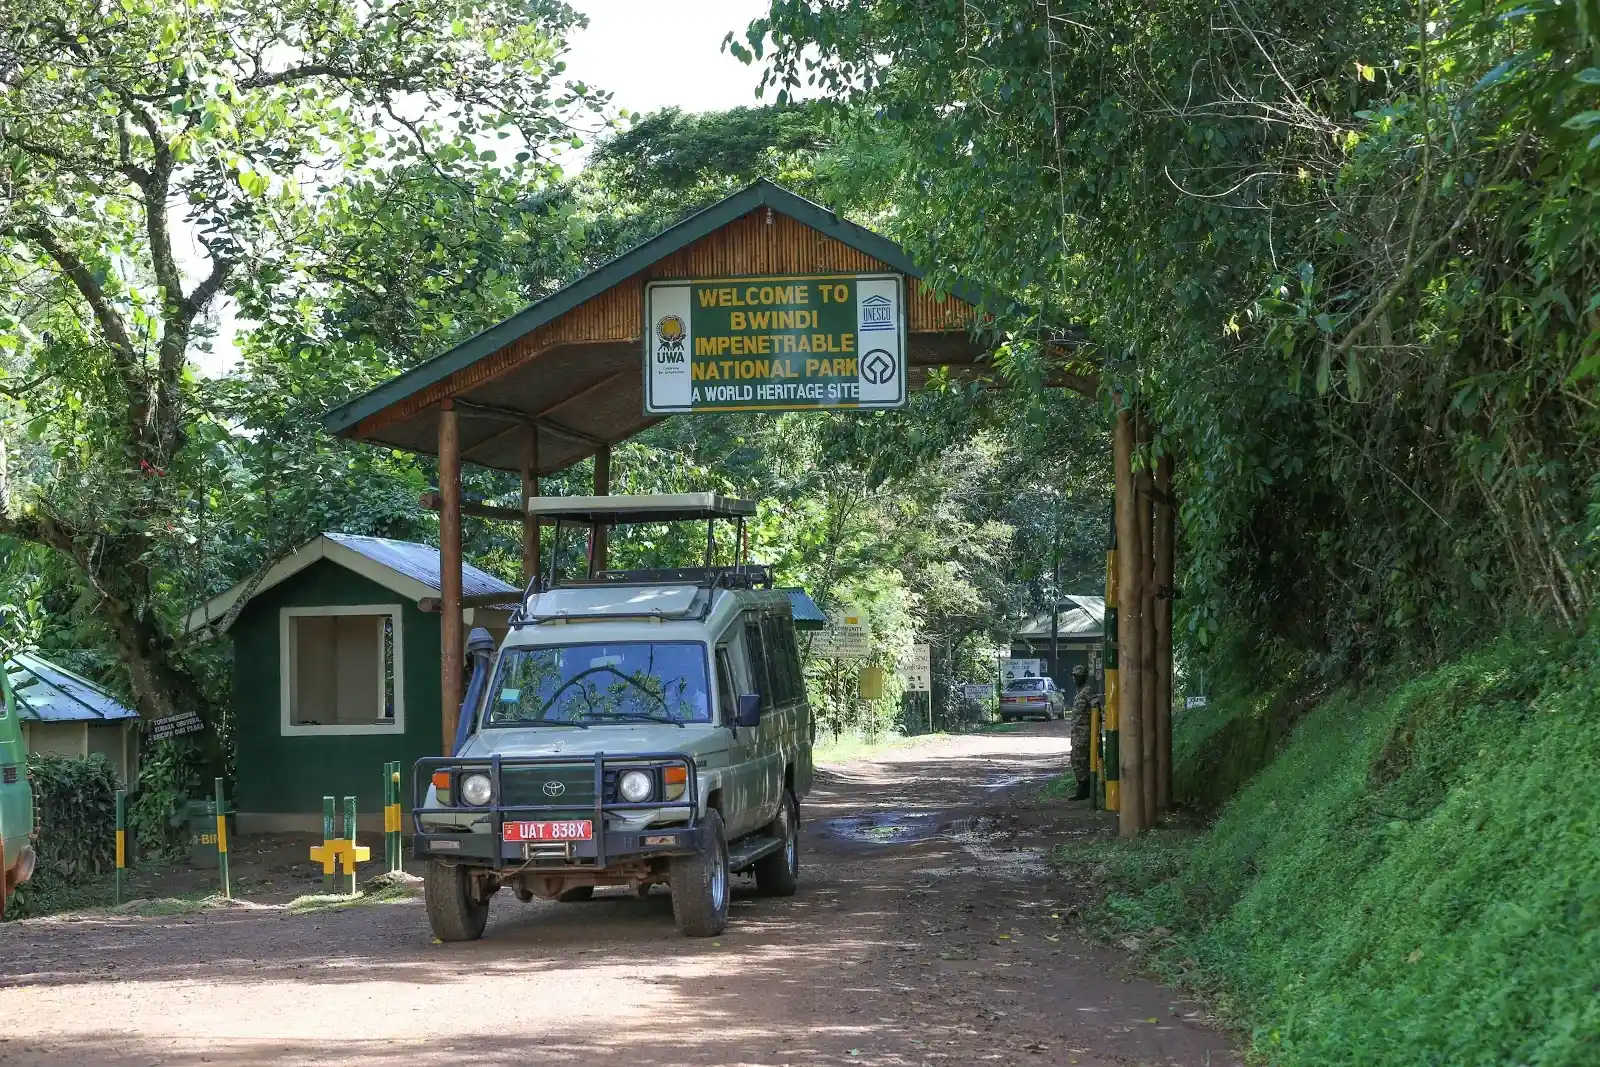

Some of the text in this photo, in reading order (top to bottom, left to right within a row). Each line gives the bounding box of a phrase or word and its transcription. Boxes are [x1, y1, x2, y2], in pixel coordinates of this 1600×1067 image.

[698, 284, 849, 307] WELCOME TO
[730, 310, 818, 331] BWINDI
[863, 306, 891, 321] UNESCO
[695, 334, 855, 356] IMPENETRABLE
[657, 351, 685, 364] UWA
[691, 358, 859, 381] NATIONAL PARK
[691, 382, 860, 402] A WORLD HERITAGE SITE
[520, 823, 584, 839] UAT 838X
